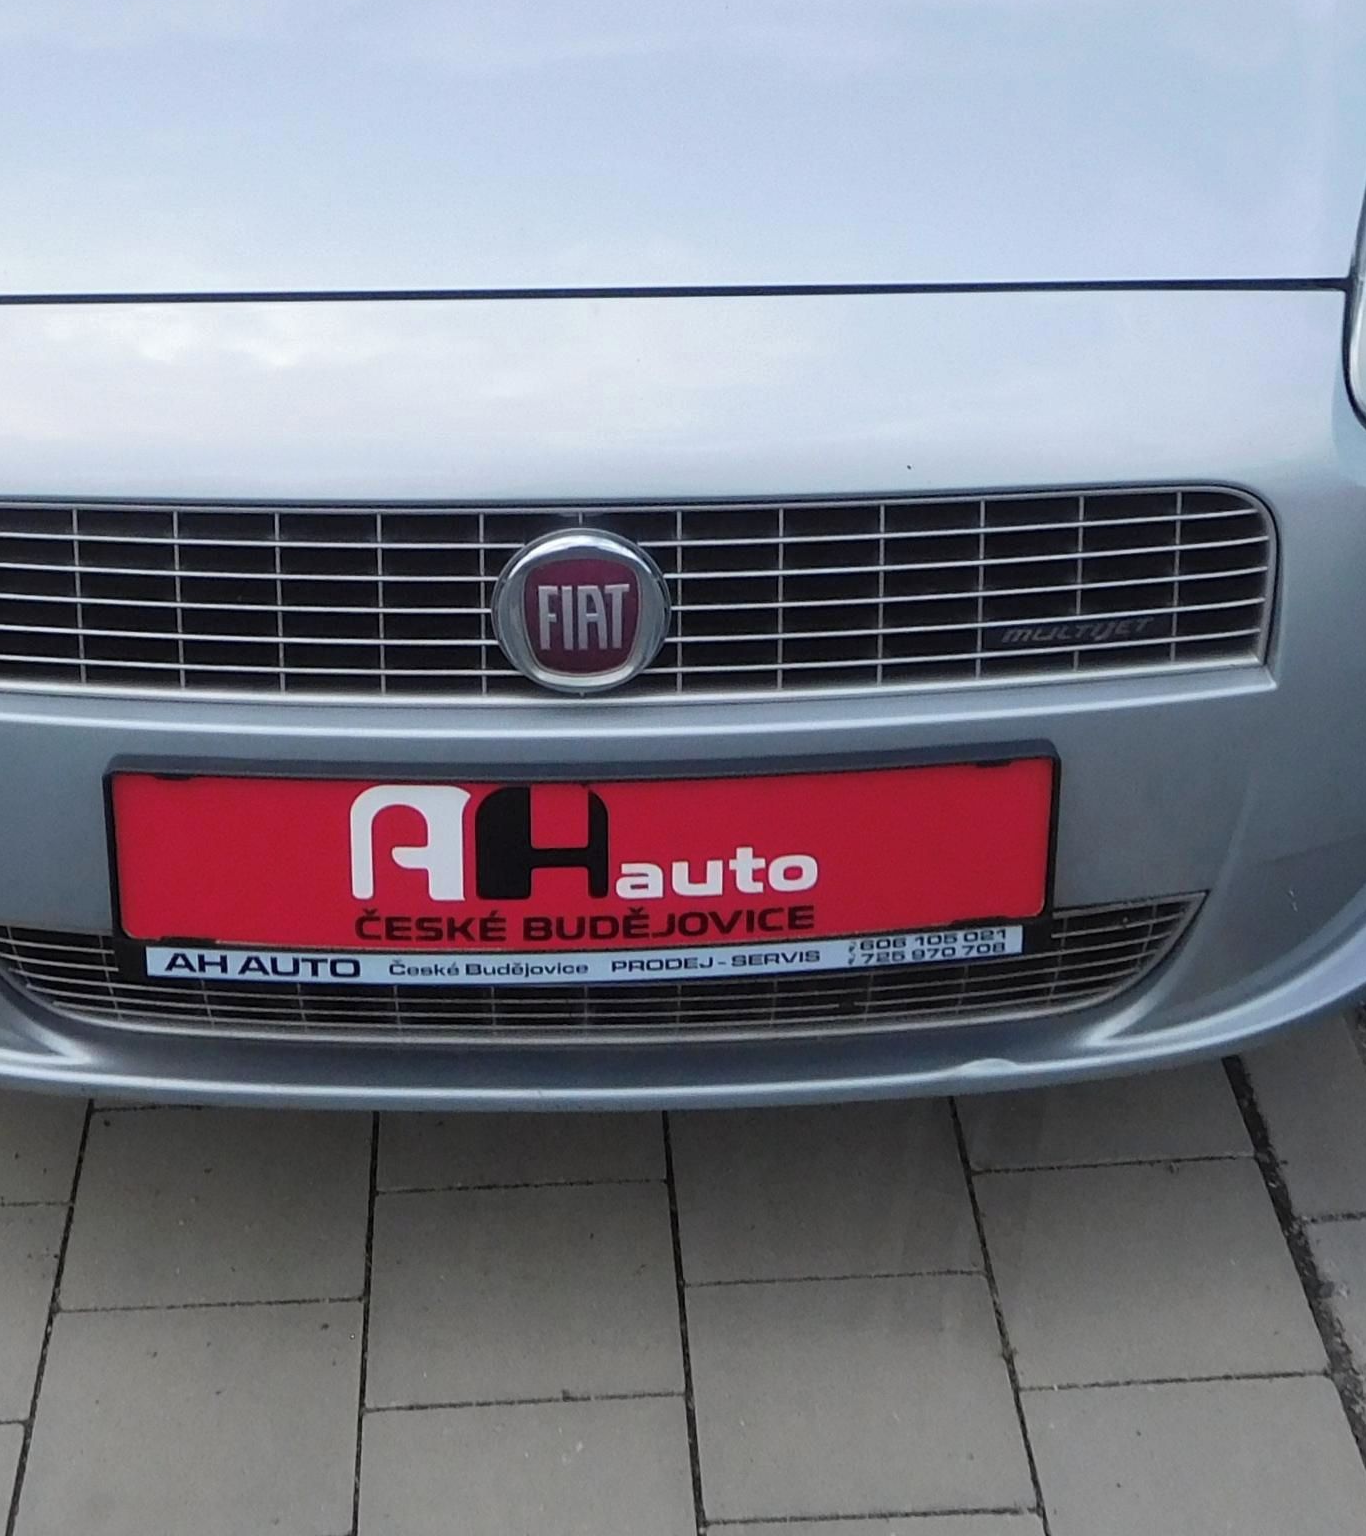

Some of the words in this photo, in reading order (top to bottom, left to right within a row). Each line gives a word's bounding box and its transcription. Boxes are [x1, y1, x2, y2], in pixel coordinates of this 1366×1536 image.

[537, 583, 630, 651] FIAT
[349, 784, 609, 901] AH
[616, 846, 818, 900] auto
[354, 908, 507, 942] ČESKÉ
[523, 905, 815, 942] BUDĚJOVICE
[859, 938, 907, 952] 606
[914, 932, 958, 946] 105
[963, 928, 1007, 943] 021
[164, 952, 229, 975] AH
[237, 955, 362, 978] AUTO
[388, 959, 460, 977] České
[465, 962, 589, 978] Budějovice
[611, 956, 713, 973] PRODEJ
[731, 950, 821, 967] SERVIS
